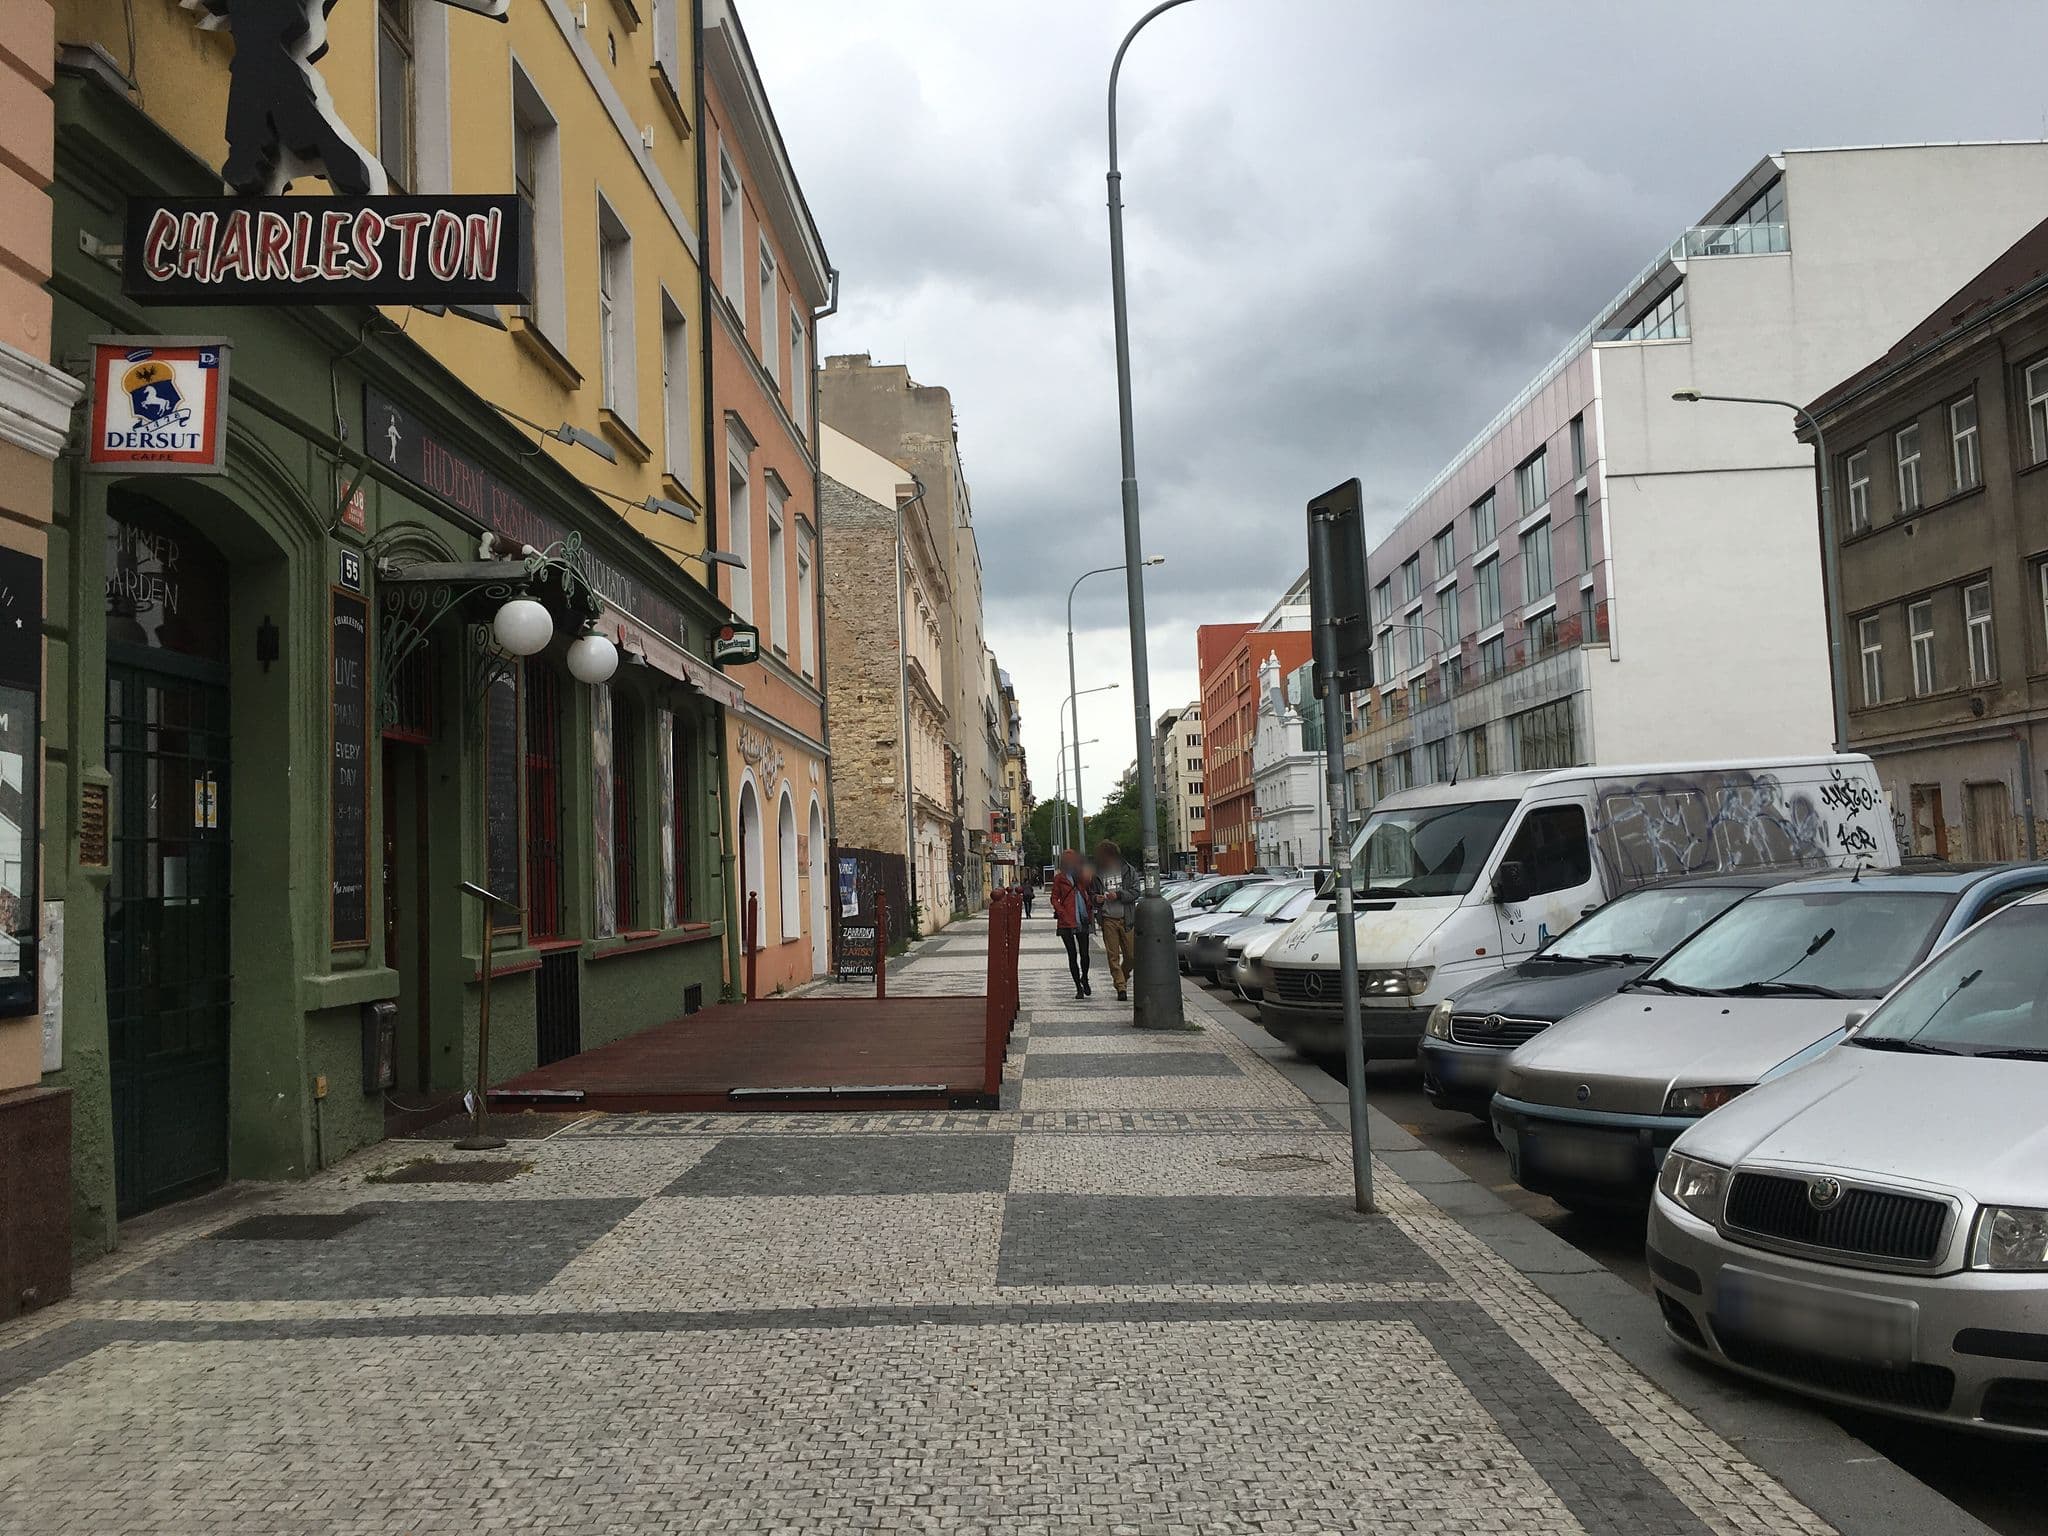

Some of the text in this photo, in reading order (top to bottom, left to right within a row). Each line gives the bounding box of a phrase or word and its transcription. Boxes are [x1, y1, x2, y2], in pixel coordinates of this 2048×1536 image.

[142, 206, 503, 284] CHARLESTON
[106, 431, 201, 449] DERSUT
[422, 436, 486, 519] HUDEBNÍ
[345, 558, 359, 581] 55
[334, 615, 364, 634] CHARLESTON
[335, 656, 359, 689] LIVE
[335, 741, 361, 760] EVERY
[340, 767, 357, 787] DAY
